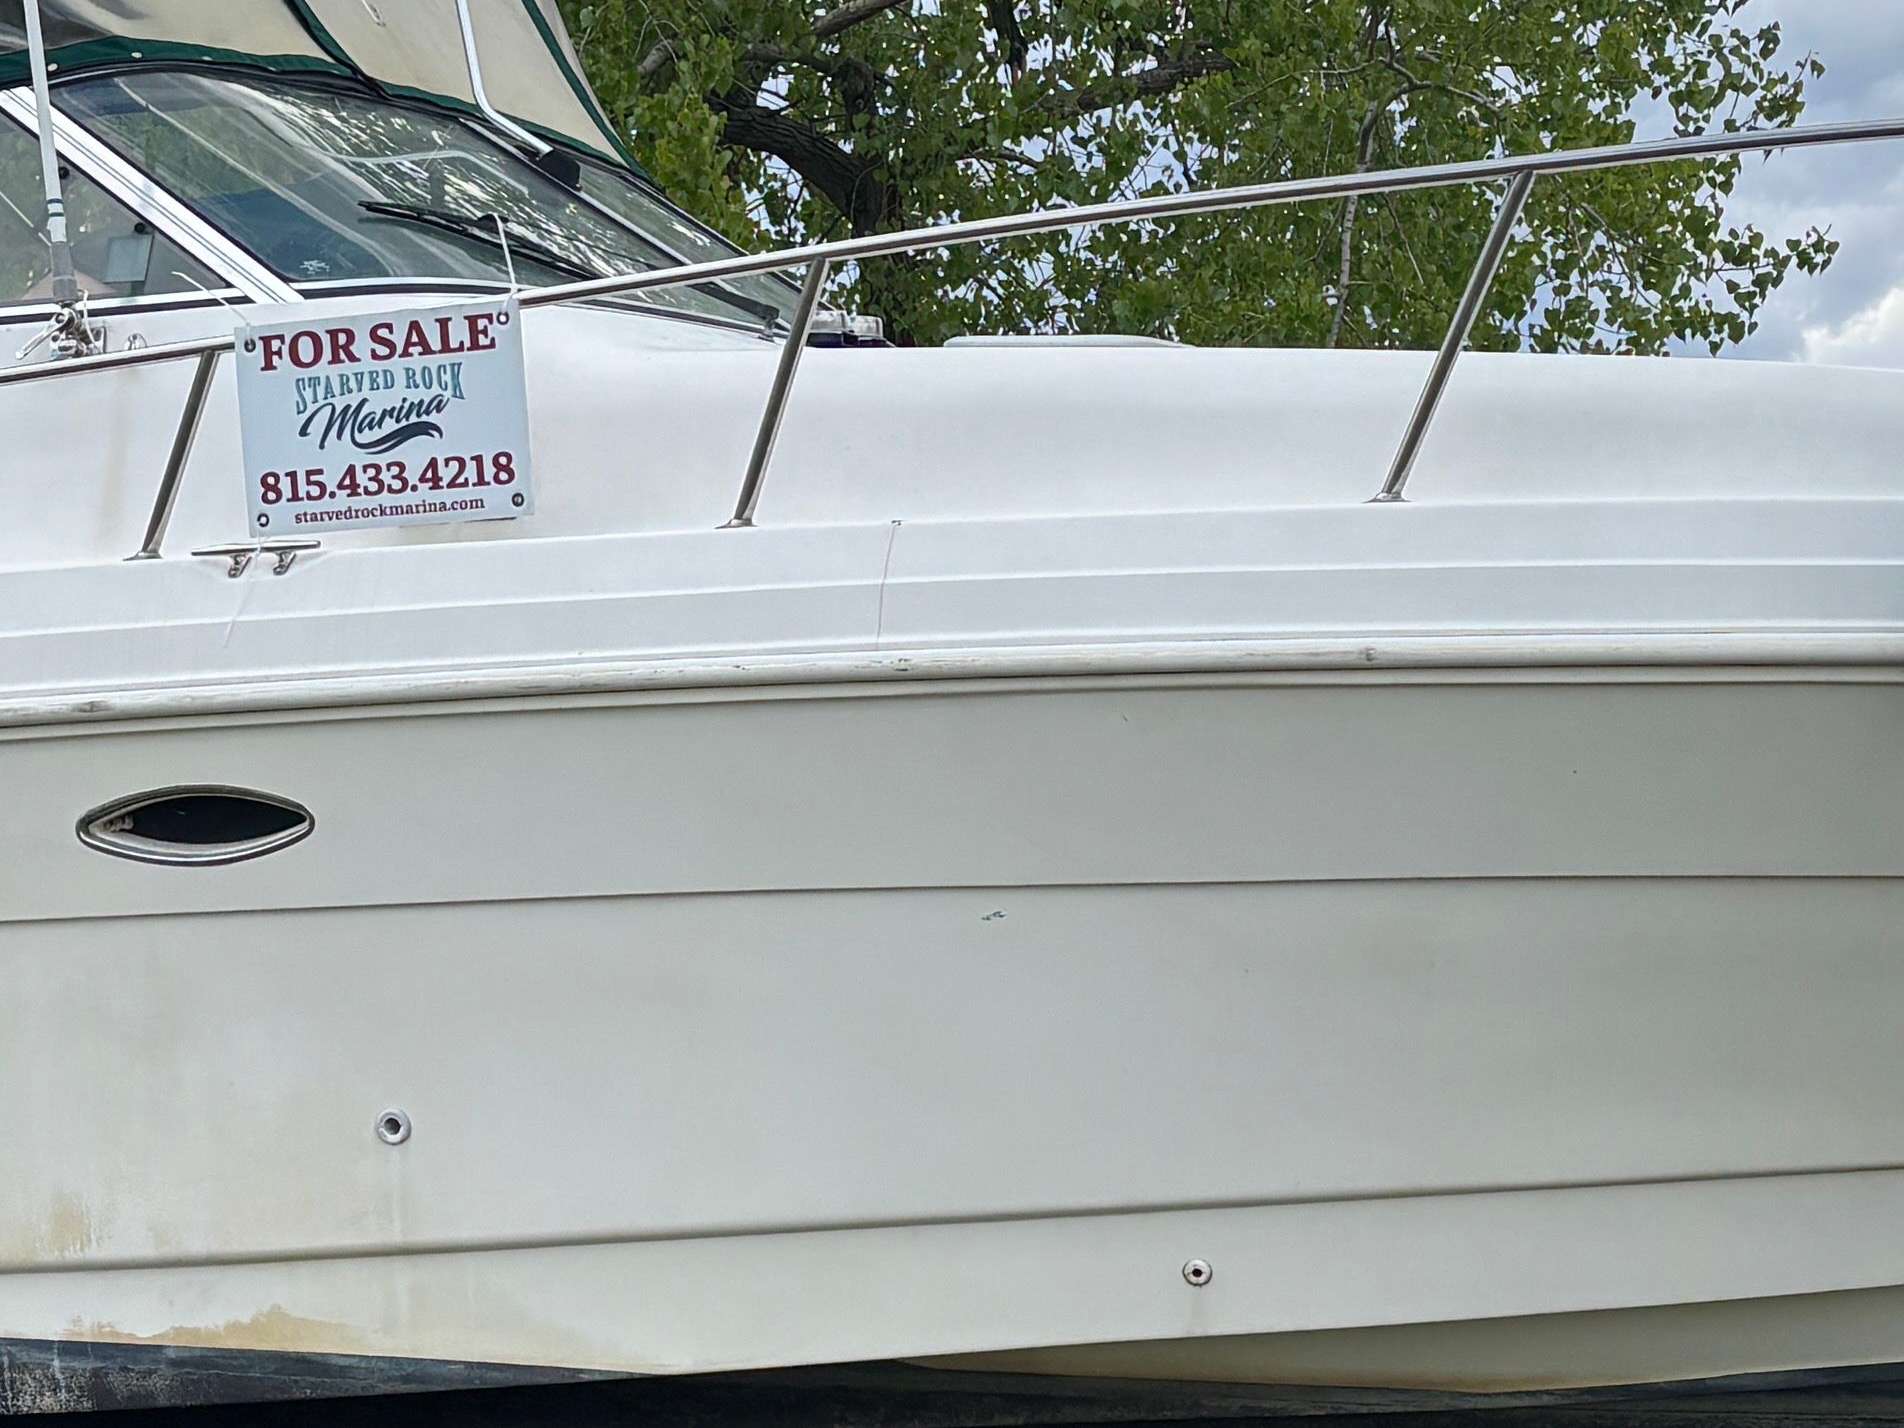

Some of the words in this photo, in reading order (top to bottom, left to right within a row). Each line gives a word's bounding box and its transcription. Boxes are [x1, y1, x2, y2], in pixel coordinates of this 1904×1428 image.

[258, 327, 362, 372] FOR
[369, 313, 497, 362] SALE
[295, 368, 396, 416] STARVED
[403, 361, 466, 400] ROCK
[298, 392, 451, 451] Marina
[259, 451, 517, 506] 815.433.4218
[294, 496, 486, 524] starvedrockmarina.com
